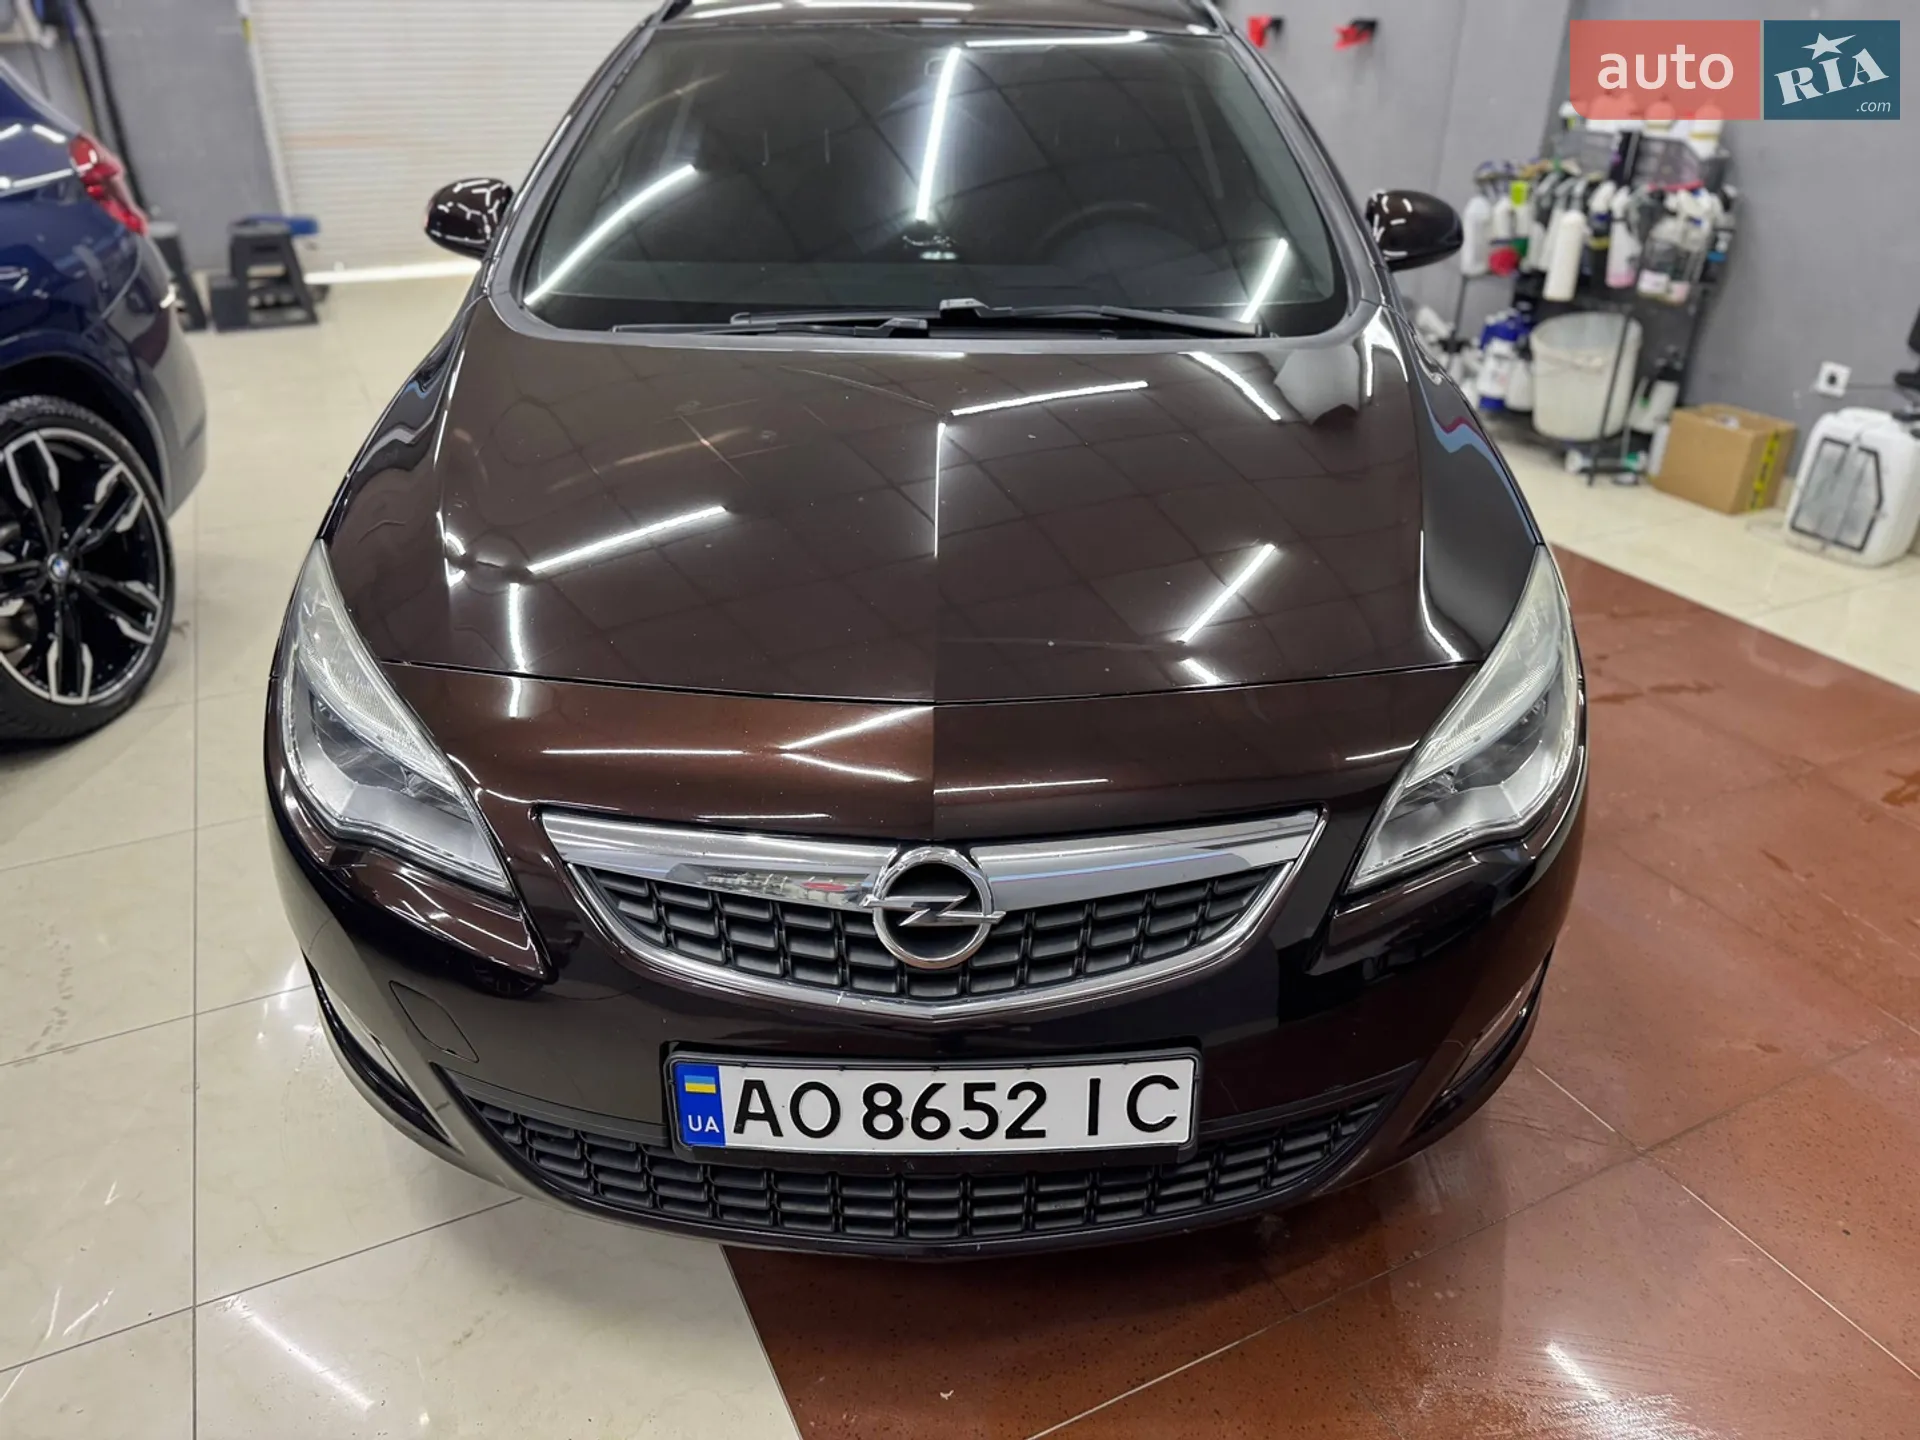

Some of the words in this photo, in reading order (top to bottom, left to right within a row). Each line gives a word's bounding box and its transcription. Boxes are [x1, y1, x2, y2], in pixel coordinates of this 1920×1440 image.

[687, 1114, 720, 1134] UA
[733, 1079, 841, 1138] AO
[862, 1081, 1047, 1140] 8652
